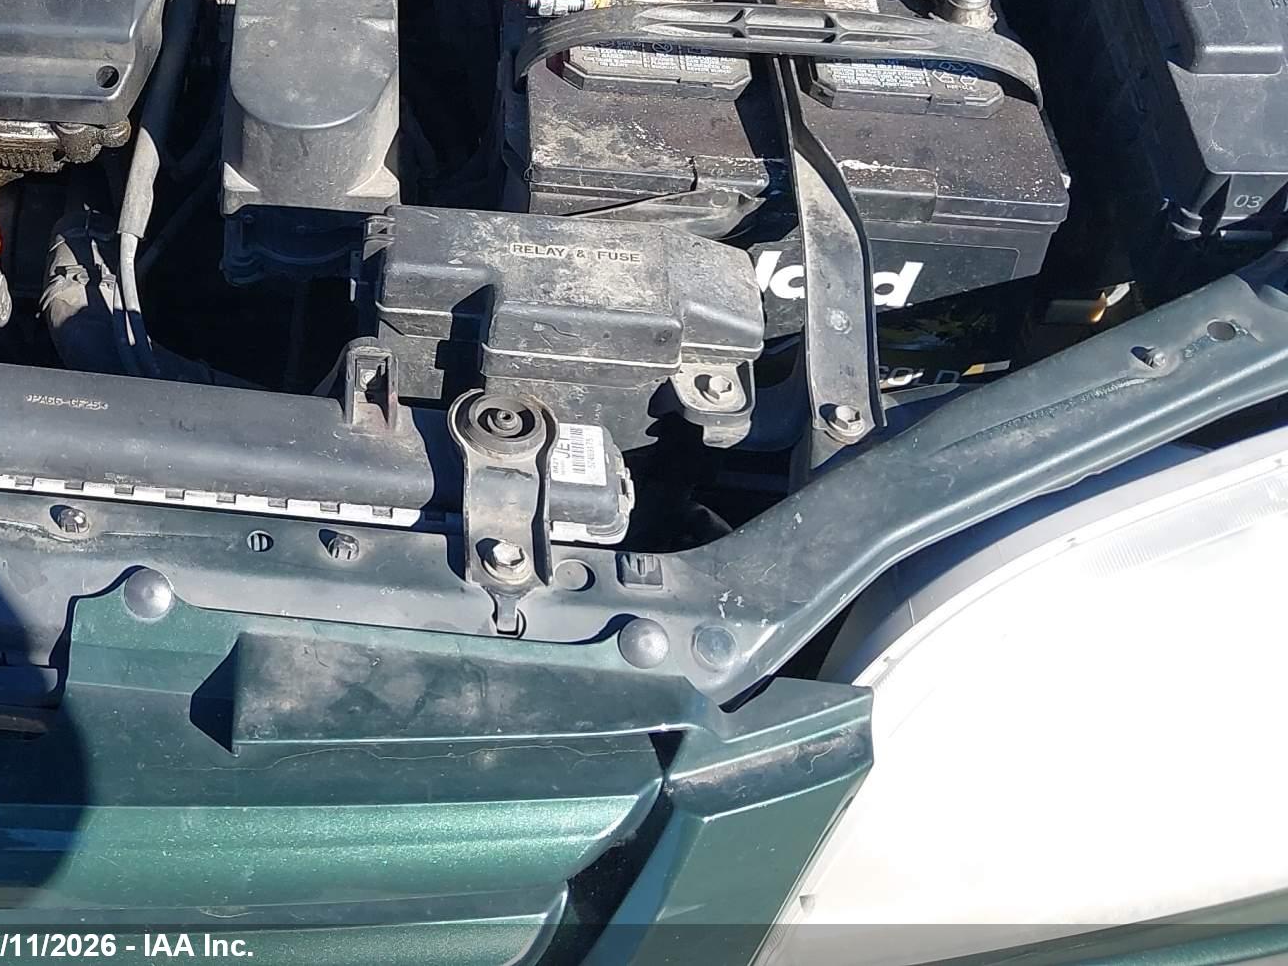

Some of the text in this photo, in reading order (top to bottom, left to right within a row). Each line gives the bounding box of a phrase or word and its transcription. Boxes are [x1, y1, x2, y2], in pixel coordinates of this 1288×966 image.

[1233, 194, 1263, 208] 03
[512, 243, 641, 263] RELAY & FUSE
